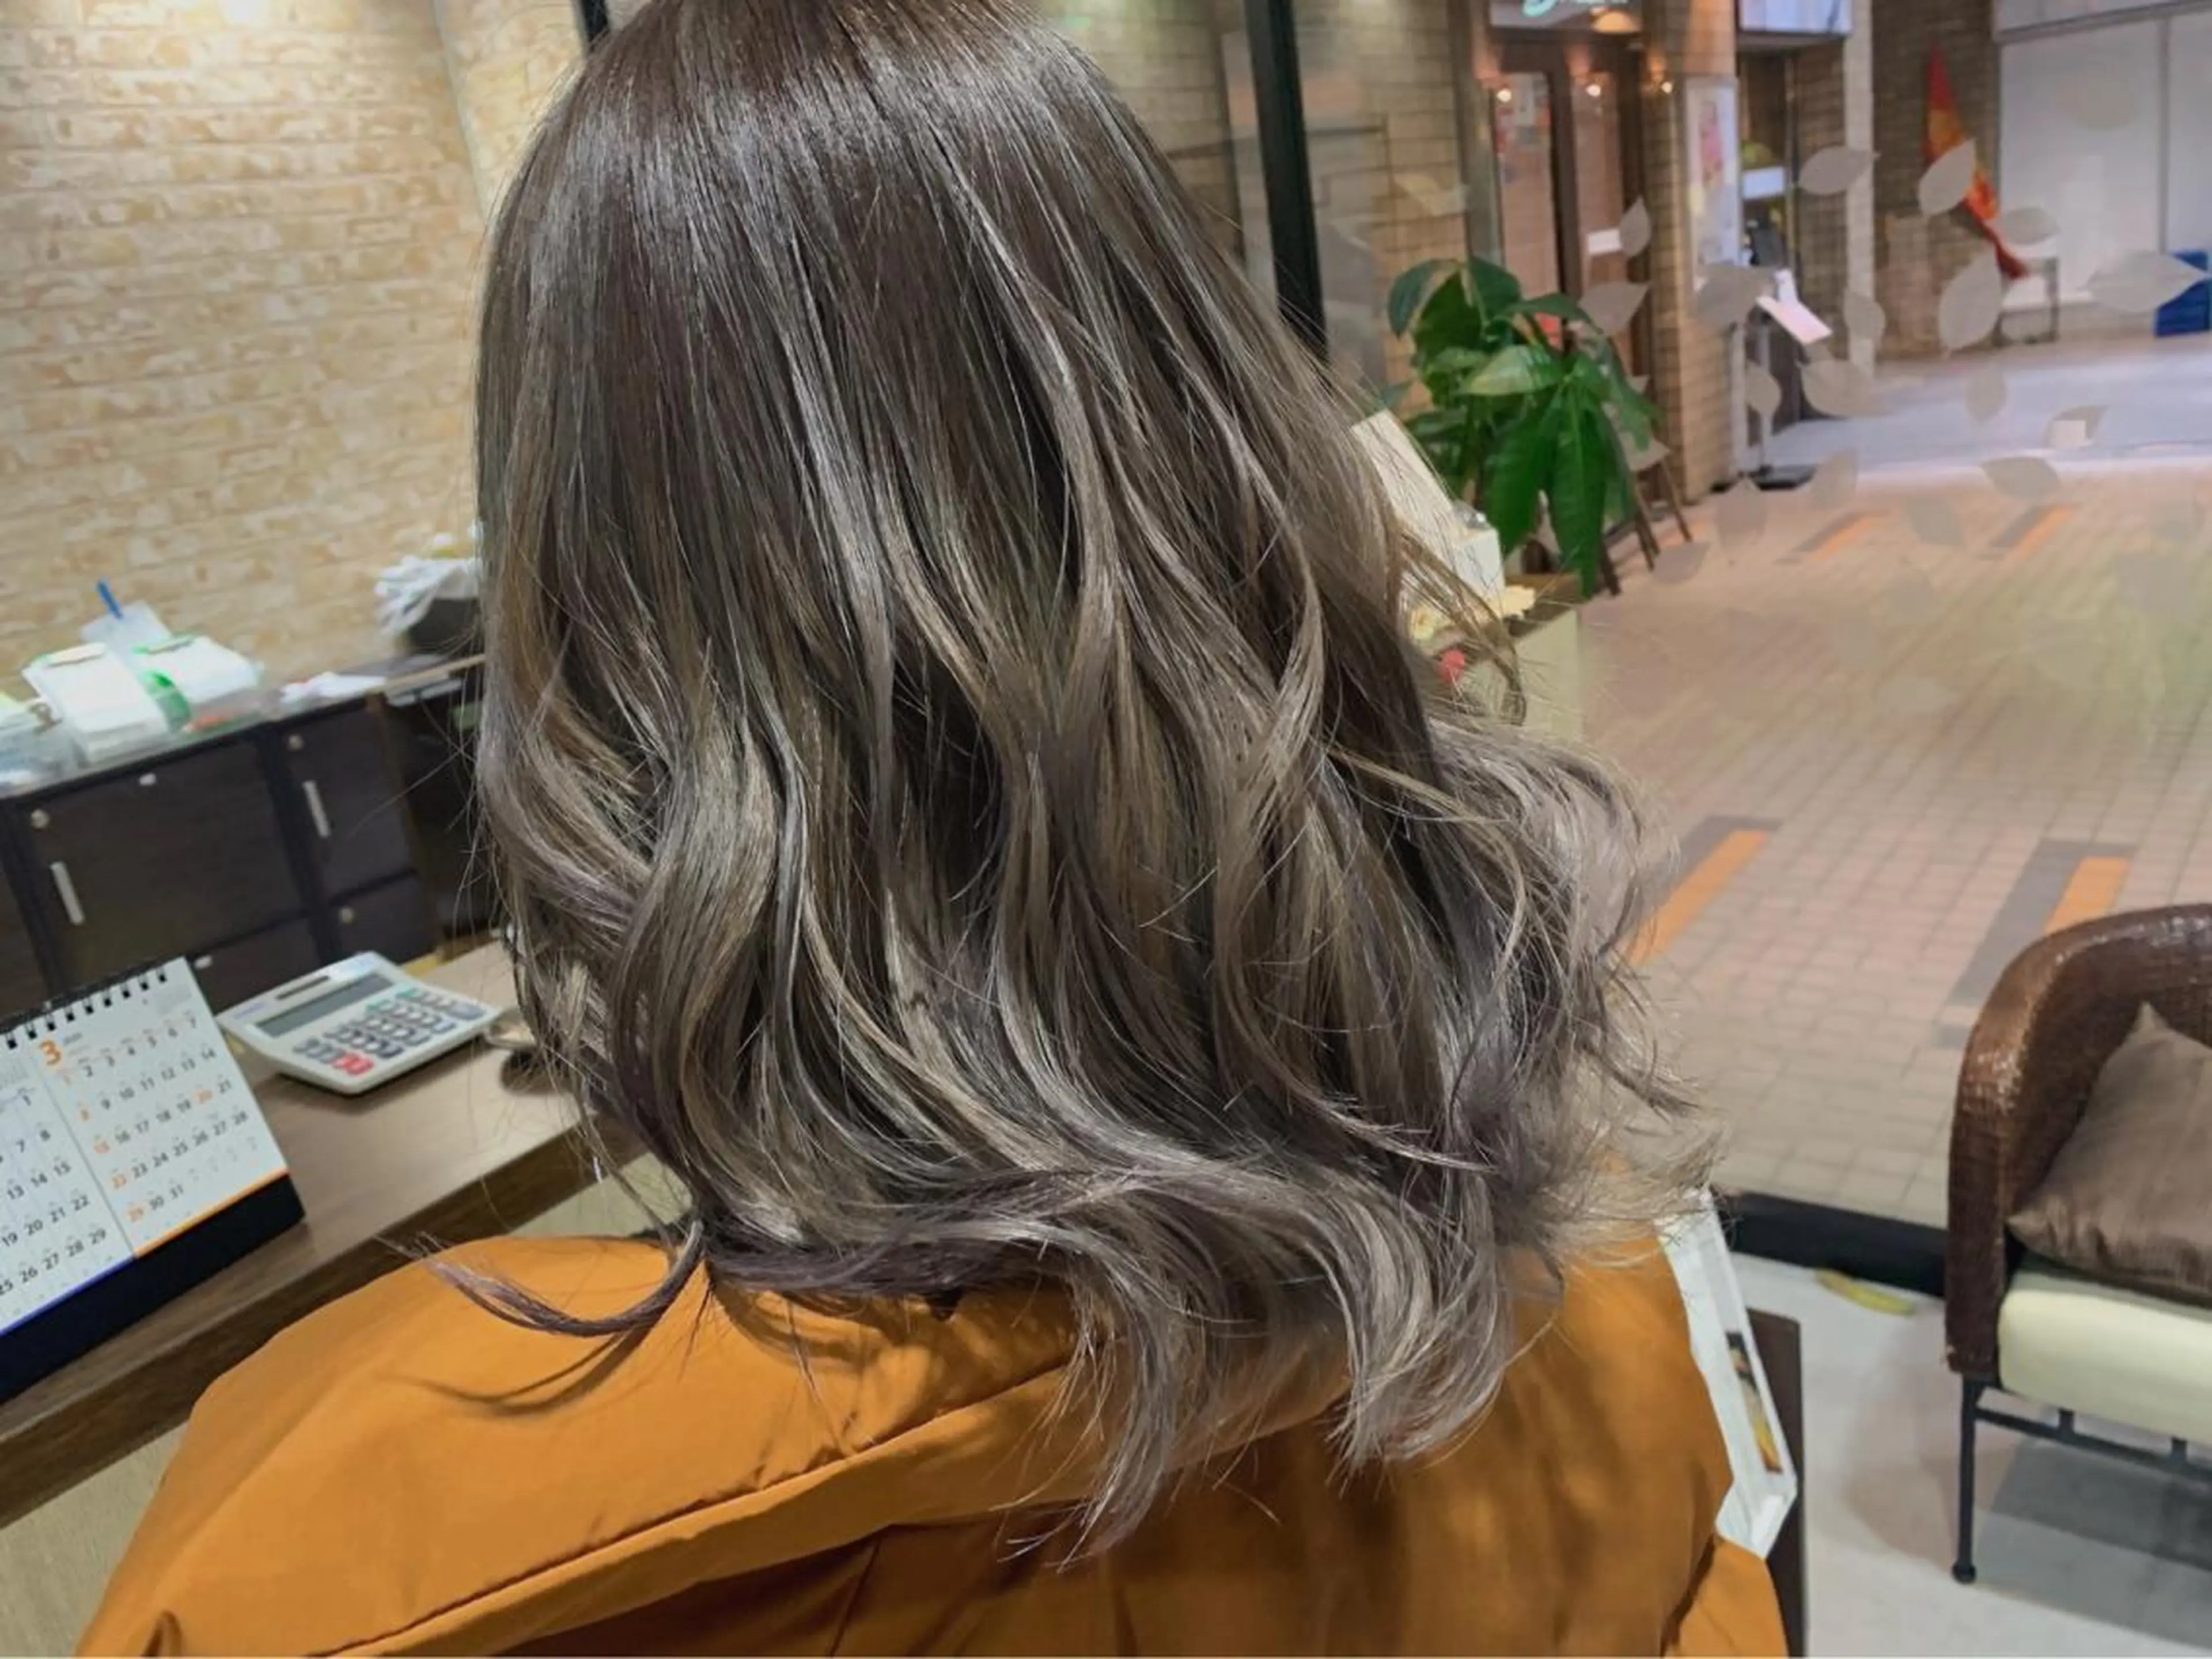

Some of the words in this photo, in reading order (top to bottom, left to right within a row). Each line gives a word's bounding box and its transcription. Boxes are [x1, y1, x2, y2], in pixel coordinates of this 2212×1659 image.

[39, 1039, 62, 1066] 3
[84, 1065, 93, 1077] 2
[119, 1086, 135, 1100] 10
[139, 1077, 156, 1091] 11
[160, 1066, 176, 1081] 12
[180, 1058, 196, 1071] 13
[201, 1047, 217, 1060] 14
[22, 1095, 31, 1106] 1
[115, 1130, 131, 1145] 16
[135, 1119, 149, 1134] 17
[156, 1109, 171, 1123] 18
[176, 1099, 191, 1113] 19
[217, 1078, 232, 1094] 21
[16, 1139, 25, 1153] 7
[40, 1129, 51, 1142] 8
[131, 1162, 148, 1179] 23
[152, 1152, 169, 1168] 24
[173, 1141, 189, 1158] 25
[192, 1129, 209, 1147] 26
[212, 1120, 227, 1137] 27
[232, 1110, 248, 1126] 28
[7, 1185, 24, 1200] 13
[31, 1172, 48, 1187] 14
[53, 1161, 72, 1177] 15
[149, 1194, 165, 1210] 30
[169, 1184, 184, 1200] 31
[2, 1232, 18, 1247] 19
[24, 1219, 44, 1236] 20
[50, 1207, 66, 1224] 21
[71, 1194, 90, 1211] 22
[20, 1266, 39, 1284] 26
[43, 1252, 59, 1270] 27
[65, 1240, 85, 1257] 28
[88, 1228, 107, 1245] 29
